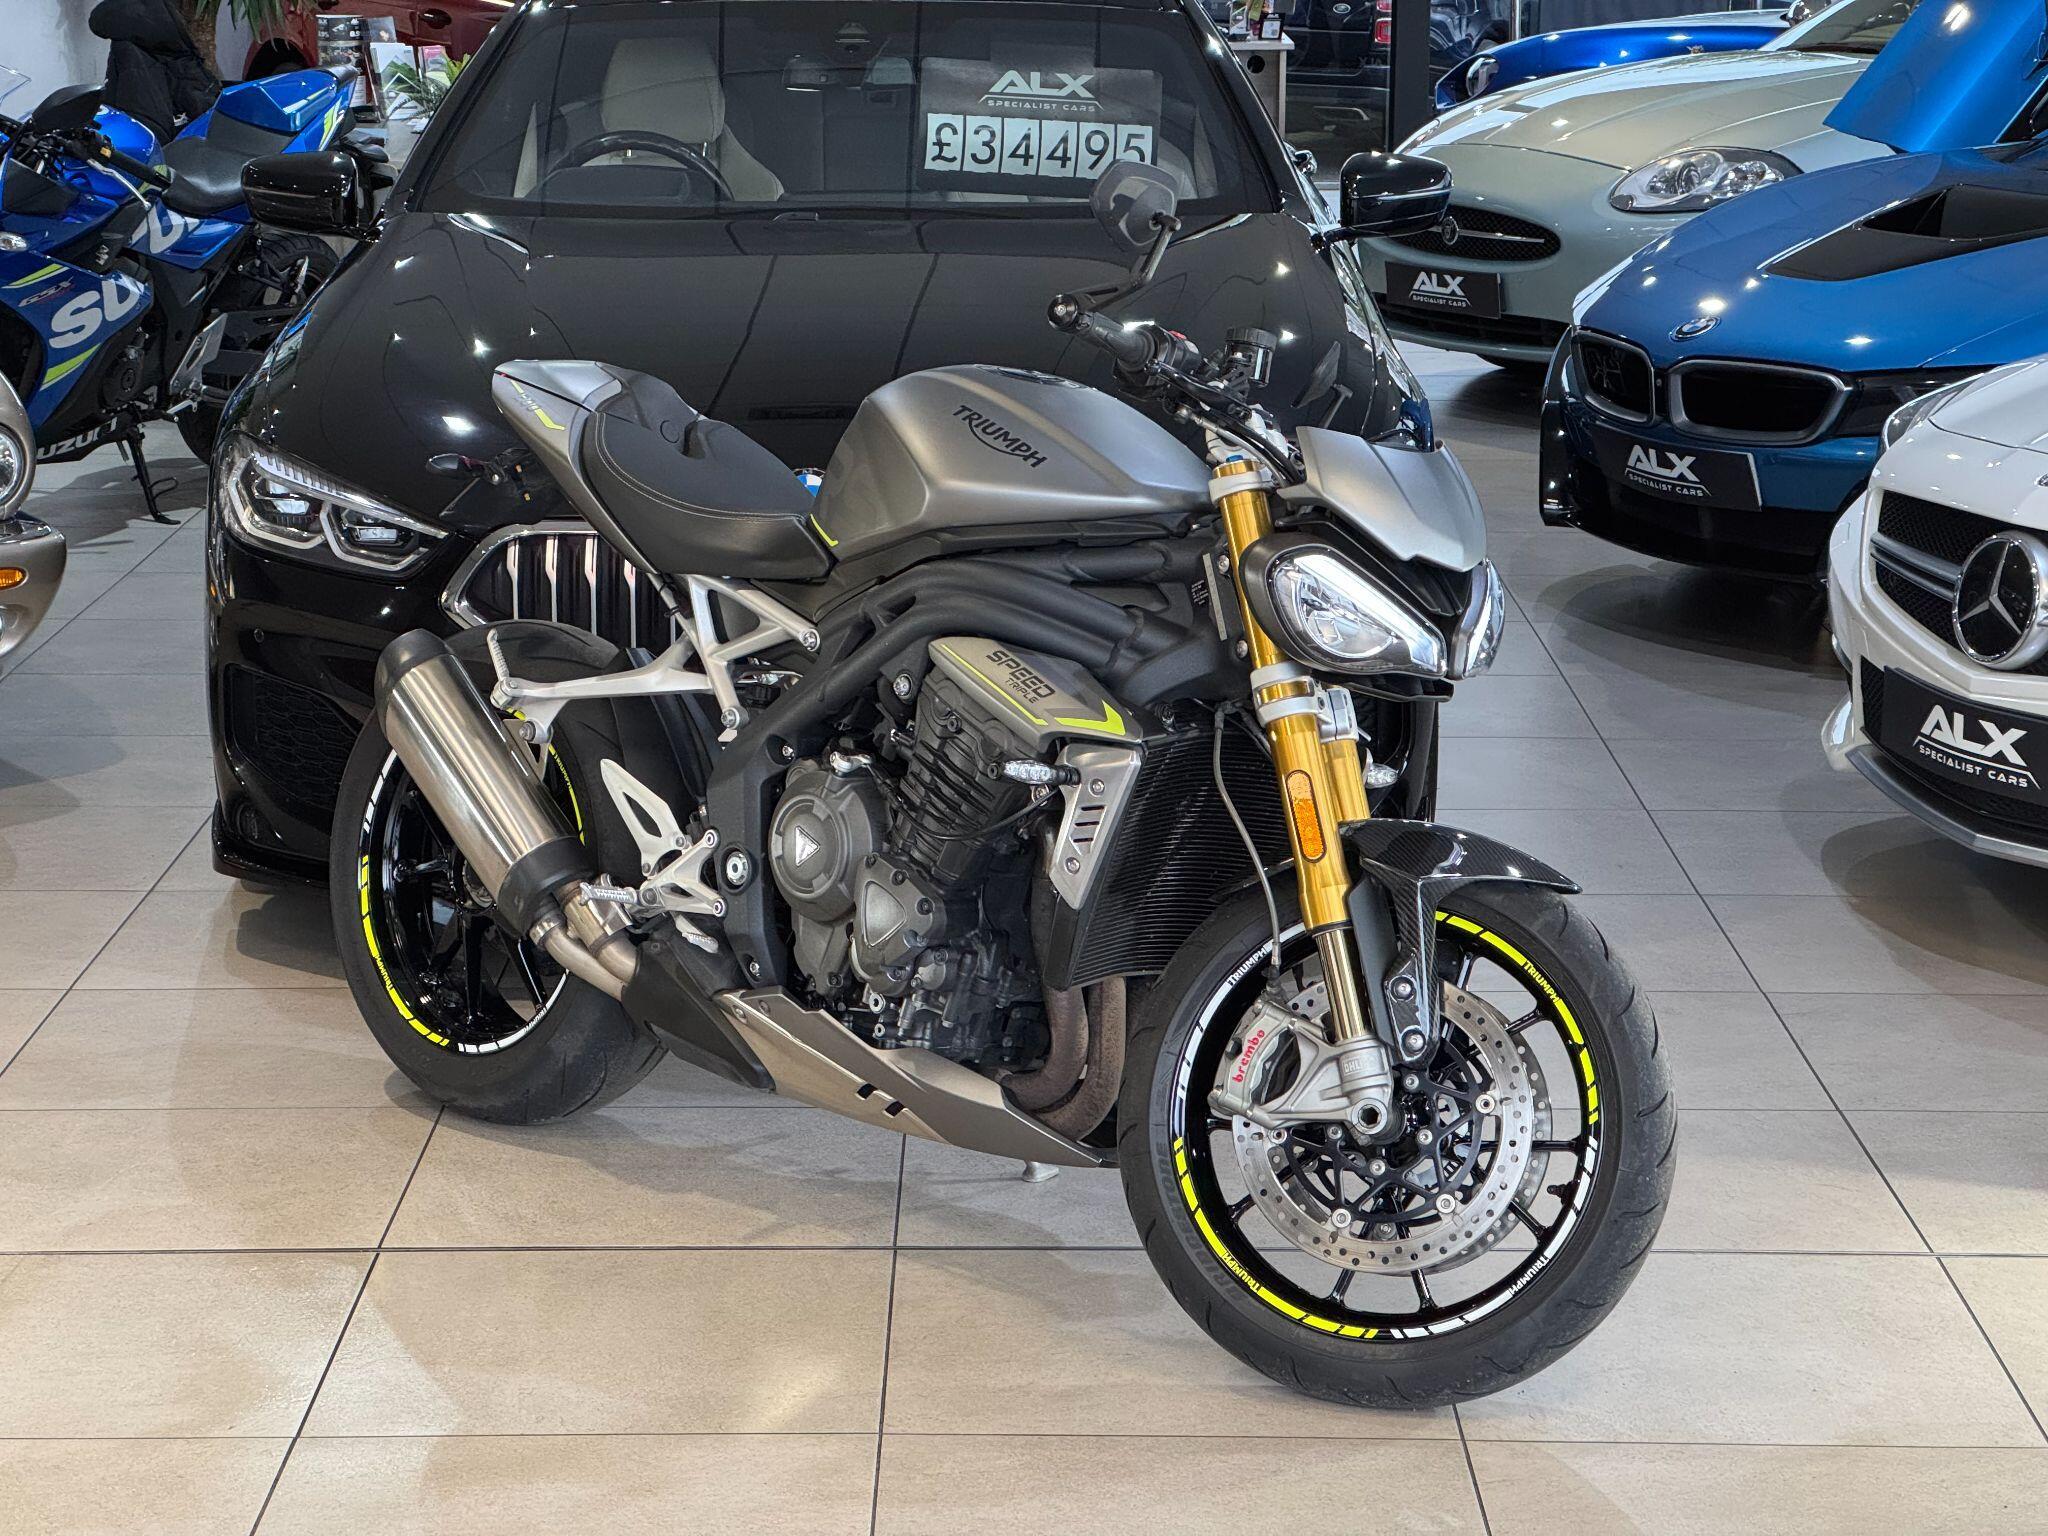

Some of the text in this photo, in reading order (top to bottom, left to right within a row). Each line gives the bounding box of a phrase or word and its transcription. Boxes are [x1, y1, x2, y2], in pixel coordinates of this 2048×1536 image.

[988, 69, 1096, 98] ALX
[987, 99, 1096, 112] SPECIALIST CARS
[930, 122, 1146, 171] £34495
[1412, 271, 1466, 296] ALX
[1412, 295, 1467, 308] SPECIALIST CARS
[952, 404, 1048, 468] TRIUMPH
[1626, 444, 1701, 482] ALX
[1628, 473, 1704, 497] SPECIALIST CARS
[985, 650, 1056, 698] SPEED
[1005, 677, 1040, 704] TRIPLE
[1920, 704, 2029, 767] ALX
[1919, 744, 2029, 788] SPECIALIST CARS
[1227, 945, 1269, 987] TRIUMPH
[1524, 960, 1560, 1003] TRIUMPH
[1231, 1028, 1266, 1083] brembo
[1222, 1251, 1263, 1293] TRIUMPH
[1509, 1255, 1550, 1296] TRIUMPH
